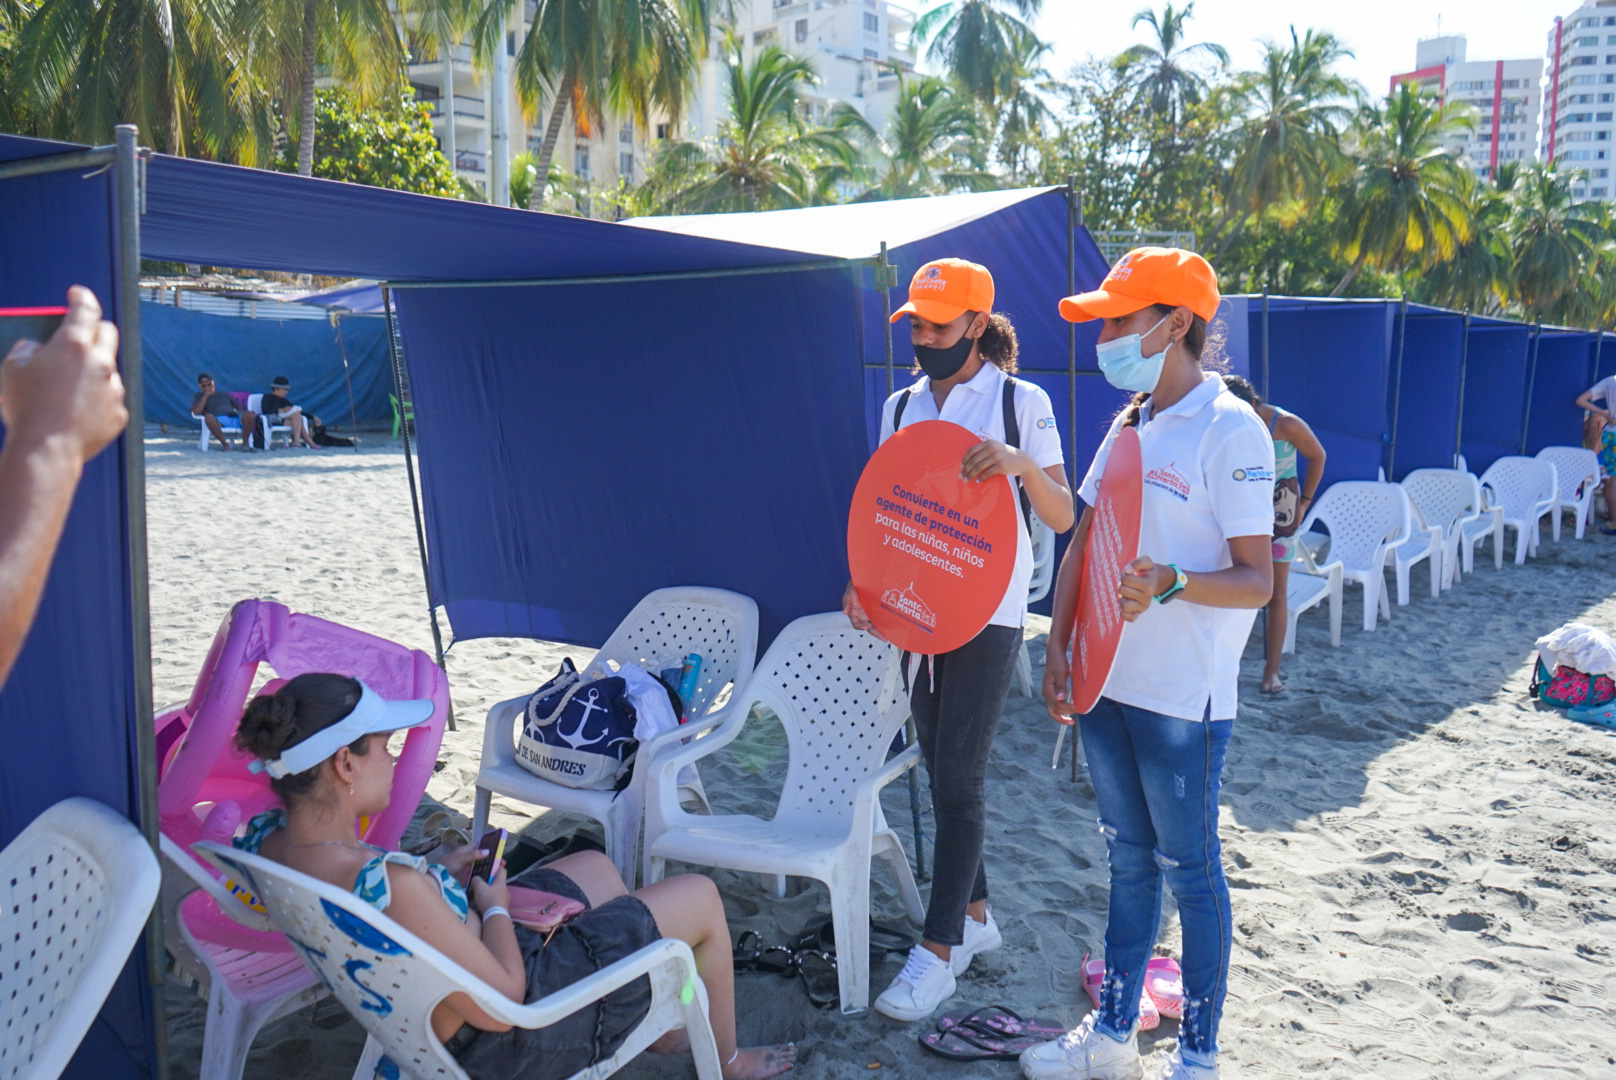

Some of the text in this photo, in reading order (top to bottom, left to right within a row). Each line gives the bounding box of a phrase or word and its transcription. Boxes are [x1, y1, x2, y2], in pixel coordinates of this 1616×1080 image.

[876, 497, 993, 554] agente de protección
[893, 485, 979, 529] Convierte en un
[875, 513, 985, 569] para las niñas, niños
[883, 534, 964, 578] y adolescentes.
[897, 599, 921, 620] Marta
[899, 594, 922, 612] Santa
[522, 746, 529, 760] DE
[530, 749, 541, 766] SAN
[541, 755, 586, 776] ANDRES
